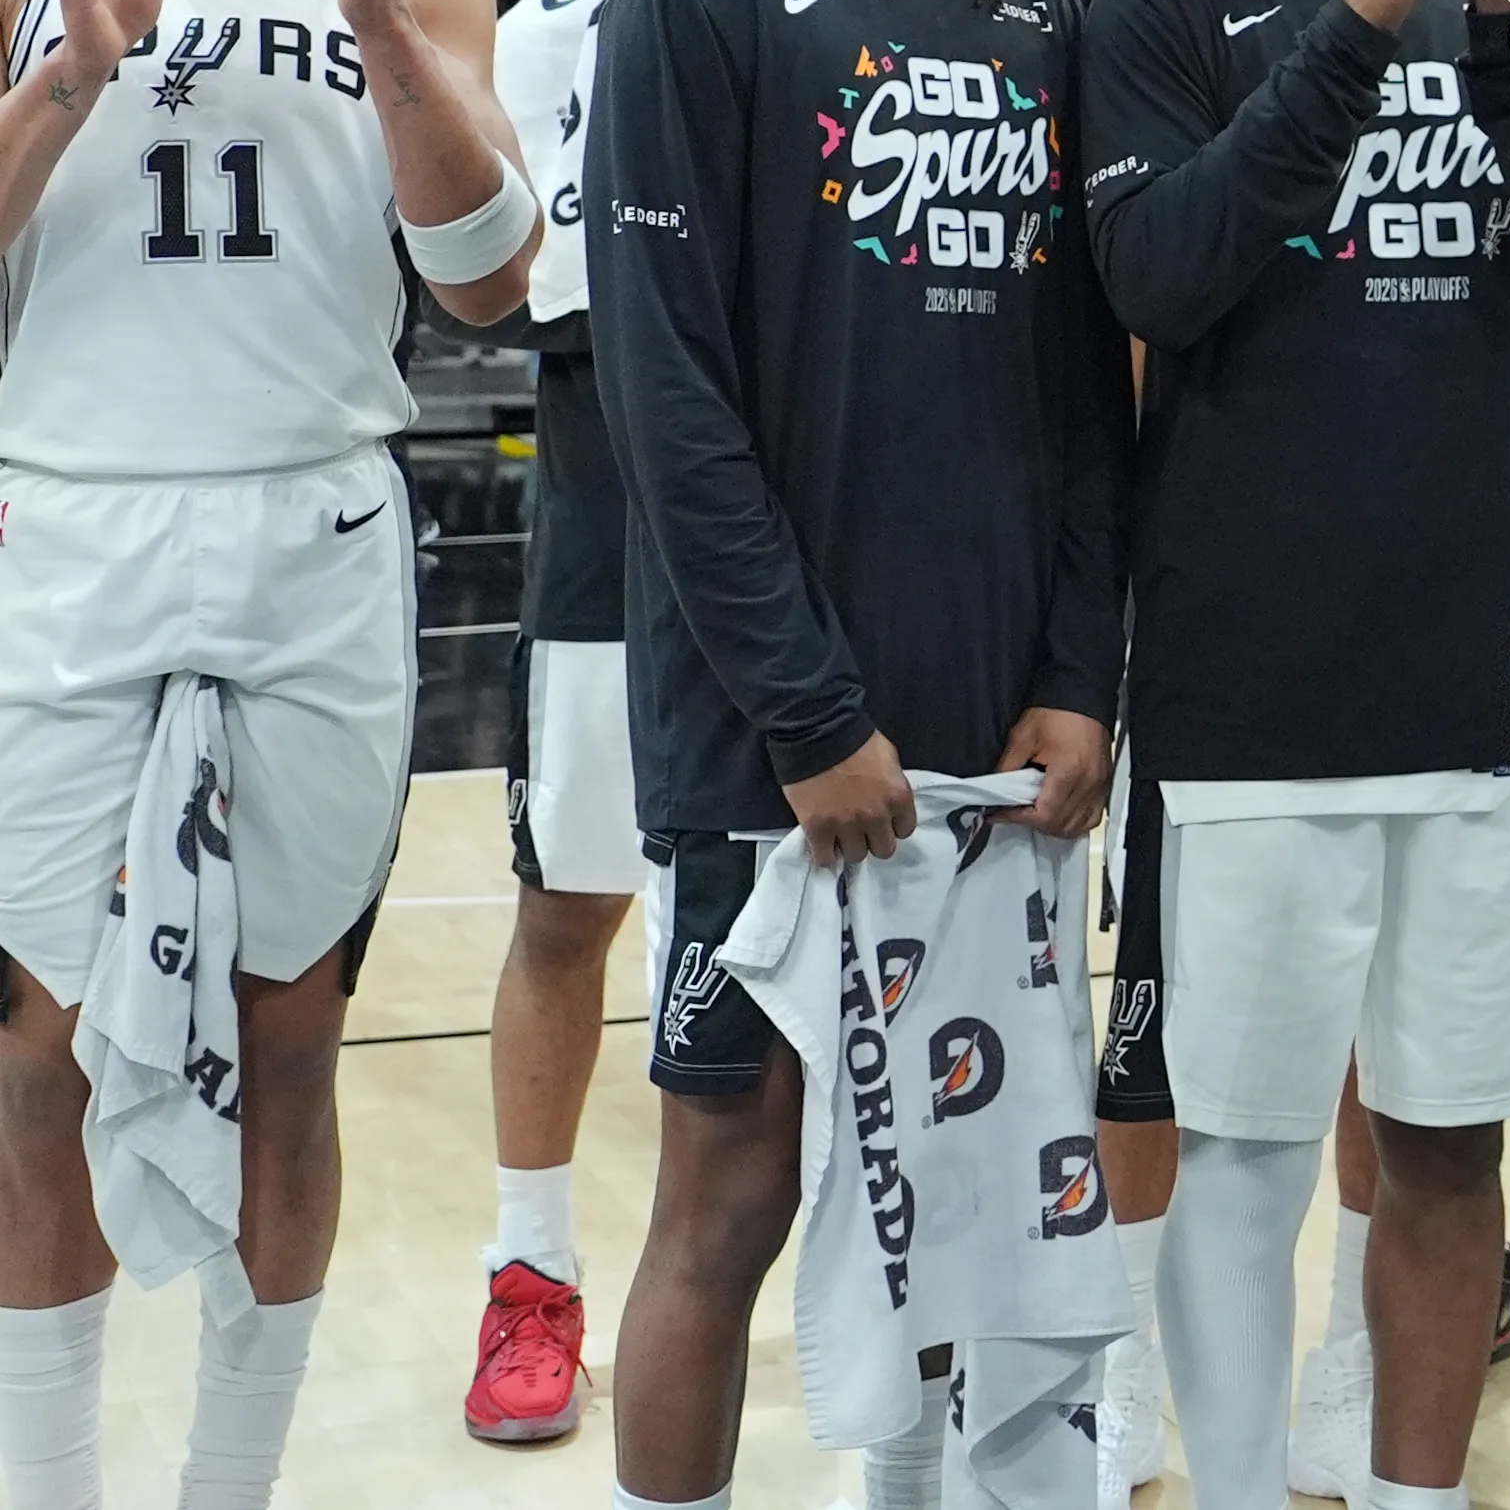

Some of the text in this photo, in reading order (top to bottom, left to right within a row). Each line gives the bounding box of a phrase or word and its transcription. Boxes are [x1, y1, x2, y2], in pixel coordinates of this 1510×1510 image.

[906, 57, 999, 120] GO
[846, 79, 1050, 238] Spurs
[1328, 114, 1504, 234] pur
[140, 139, 280, 265] 11
[618, 206, 680, 228] LEDGER
[1368, 201, 1475, 259] GO
[927, 207, 1004, 269] GO
[957, 288, 997, 314] PLOFFS
[1365, 276, 1470, 303] 2026 PLAYOFFS
[837, 870, 915, 1312] ATORADE
